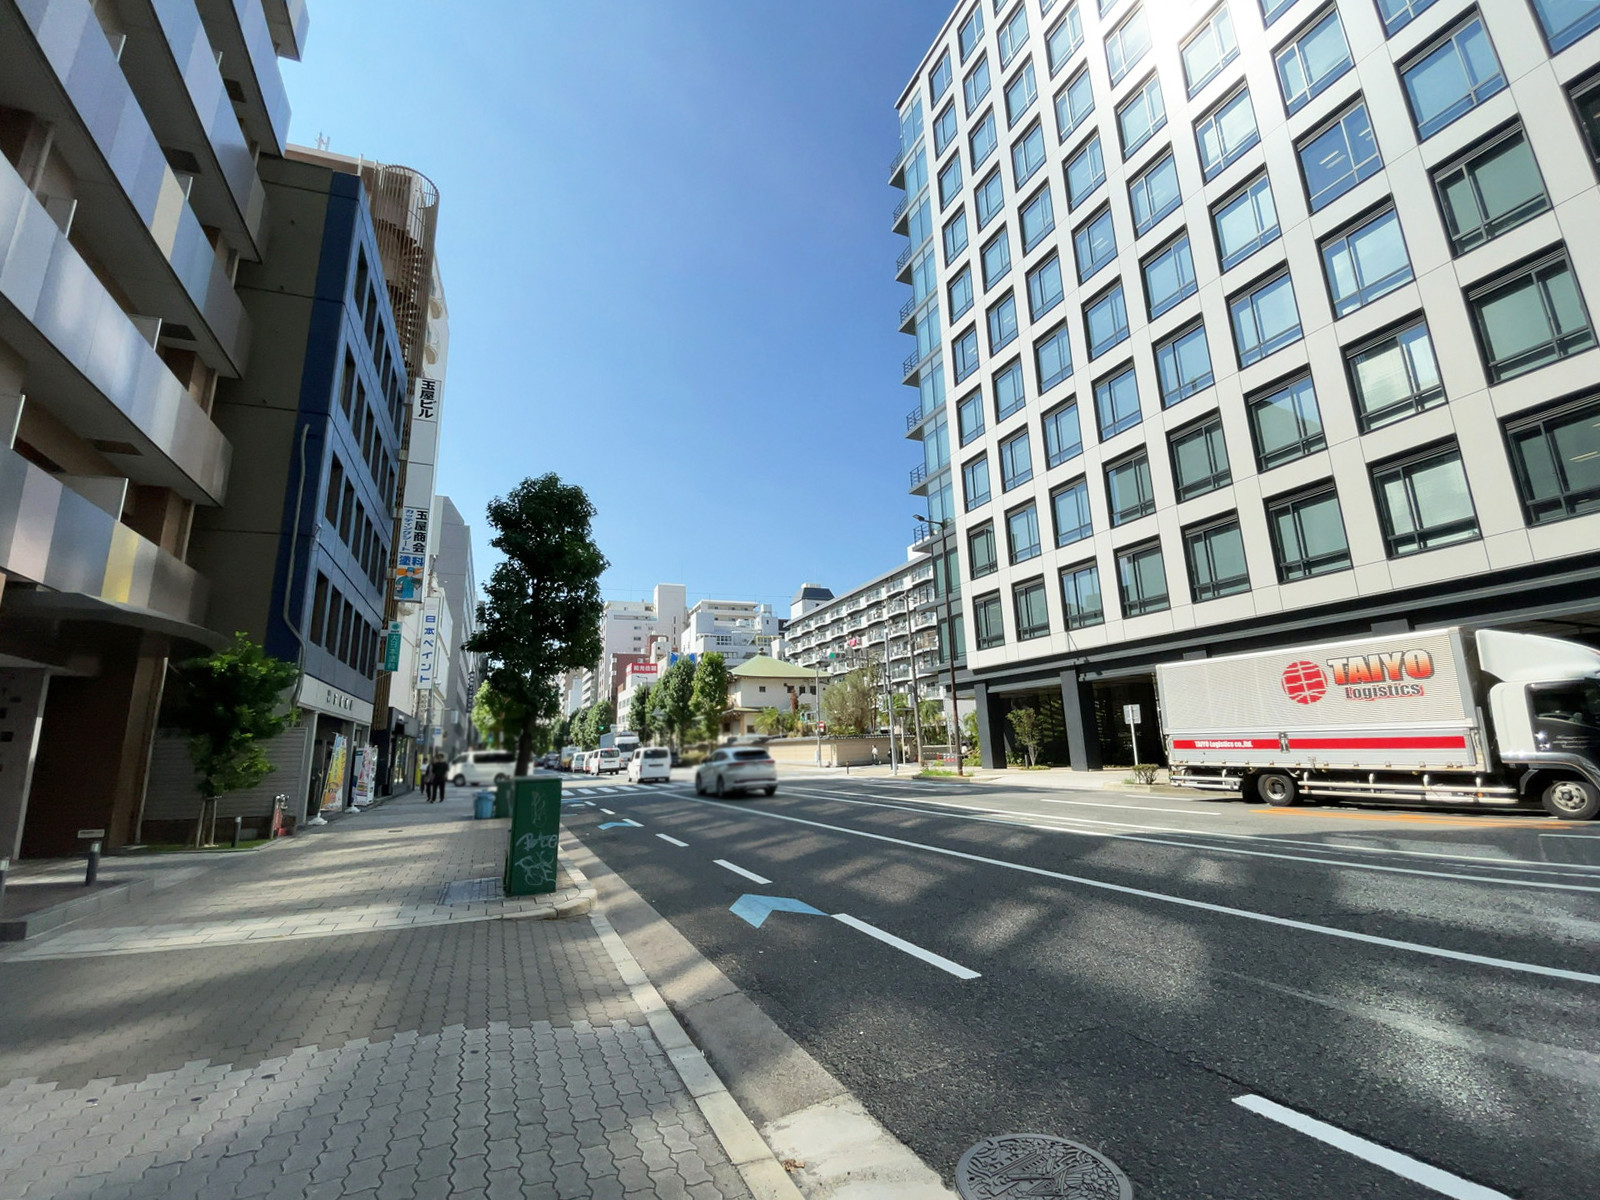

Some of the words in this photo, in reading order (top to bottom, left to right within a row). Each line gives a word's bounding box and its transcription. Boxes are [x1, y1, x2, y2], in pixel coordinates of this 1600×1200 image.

[419, 380, 436, 418] 玉屋ビル
[412, 510, 428, 553] 玉屋商会
[399, 555, 424, 566] 塗料
[420, 615, 436, 683] 日本ペイント
[1326, 649, 1435, 685] TAIYO
[1345, 683, 1422, 700] Logistics
[1210, 740, 1234, 749] Logistics
